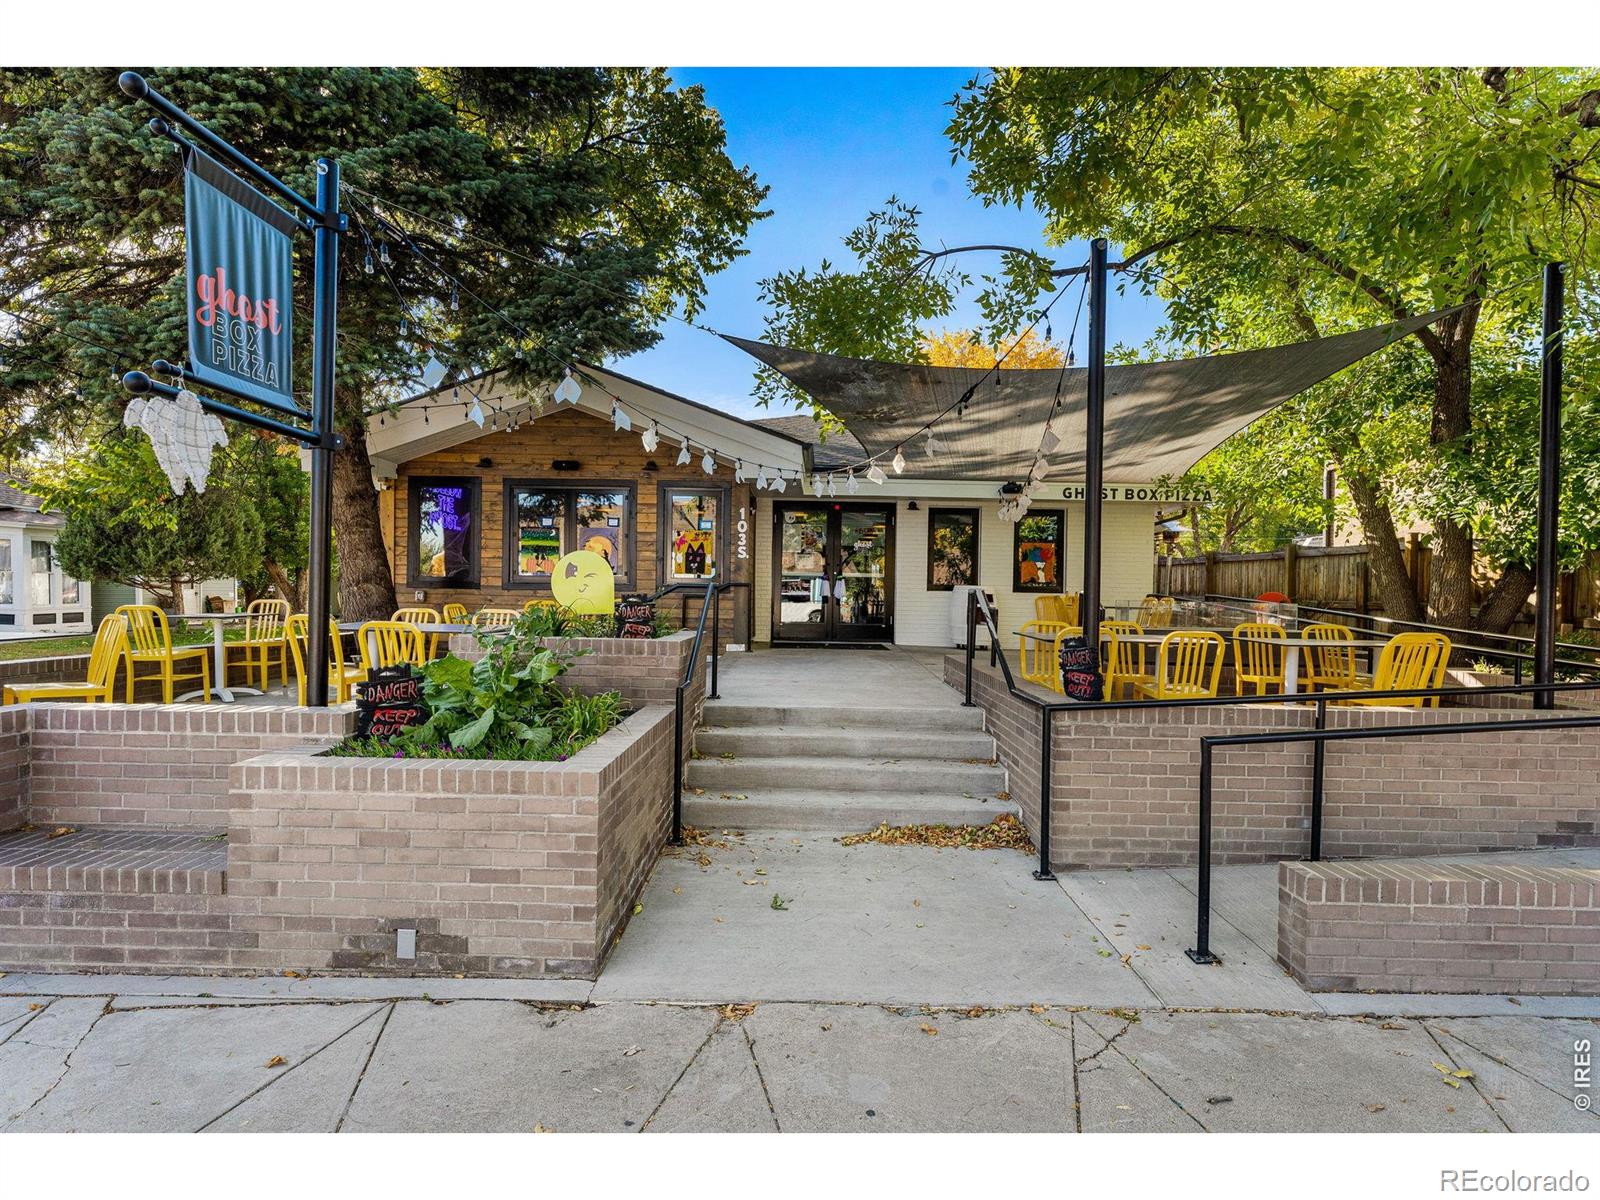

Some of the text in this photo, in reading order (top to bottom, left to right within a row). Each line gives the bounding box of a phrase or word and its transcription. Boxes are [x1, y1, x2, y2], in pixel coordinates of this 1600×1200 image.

[196, 266, 282, 335] ghost
[212, 310, 263, 355] BOX
[212, 338, 280, 388] PIZZA
[1062, 487, 1118, 499] GHST
[1125, 489, 1158, 501] BOX
[621, 605, 652, 619] DANGER
[624, 623, 651, 636] KEEP
[1063, 650, 1092, 666] DANGER
[1067, 671, 1095, 686] KEEP
[368, 680, 418, 703] DANGER
[373, 708, 417, 724] KEEP
